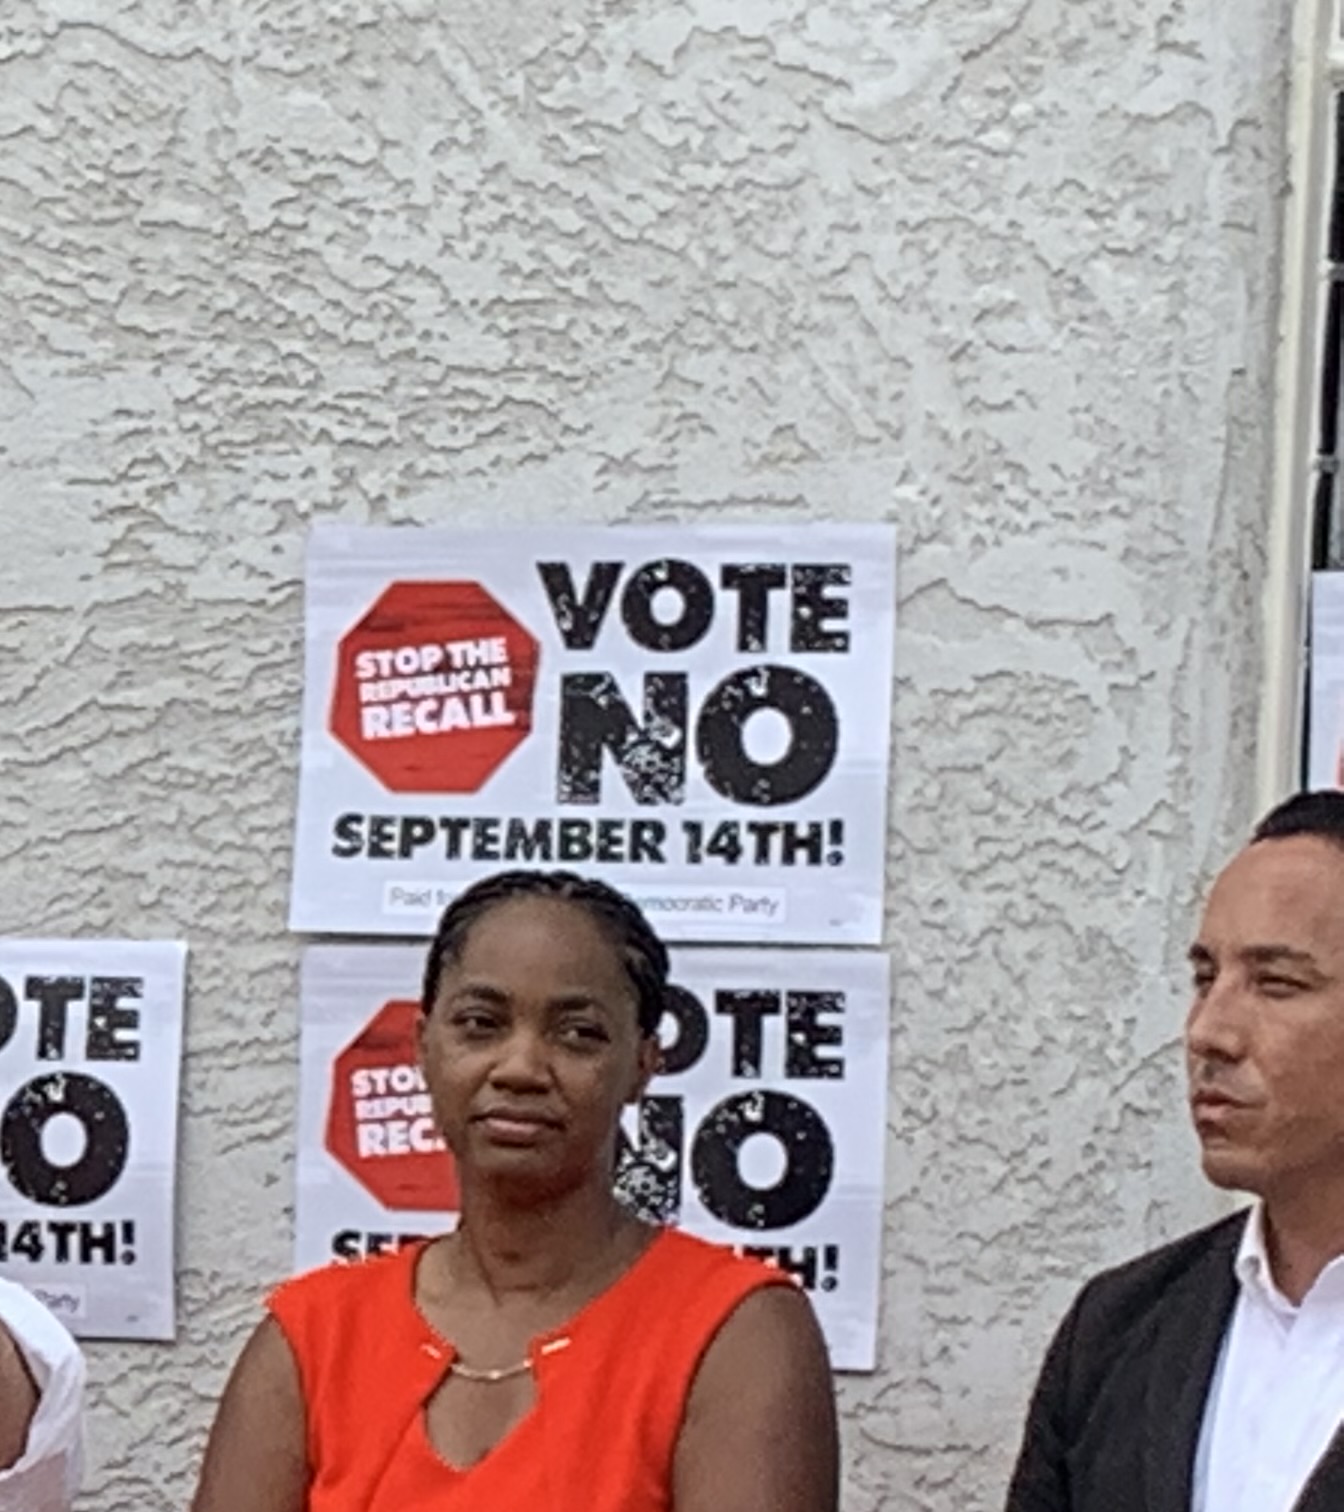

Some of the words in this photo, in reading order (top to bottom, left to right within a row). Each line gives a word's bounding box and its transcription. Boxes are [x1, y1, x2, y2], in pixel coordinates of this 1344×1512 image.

[536, 558, 851, 653] VOTE
[354, 644, 444, 679] STOP
[445, 637, 508, 668] THE
[359, 667, 511, 704] REPUBLICAN
[362, 691, 516, 741] RECALL
[557, 664, 839, 808] NO
[332, 814, 667, 863] SEPTEMBER
[682, 819, 846, 867] 14TH!
[390, 887, 432, 908] Paid
[634, 894, 723, 912] mocratic
[728, 893, 780, 917] Party
[655, 984, 846, 1079] OTE
[357, 1116, 447, 1158] REC
